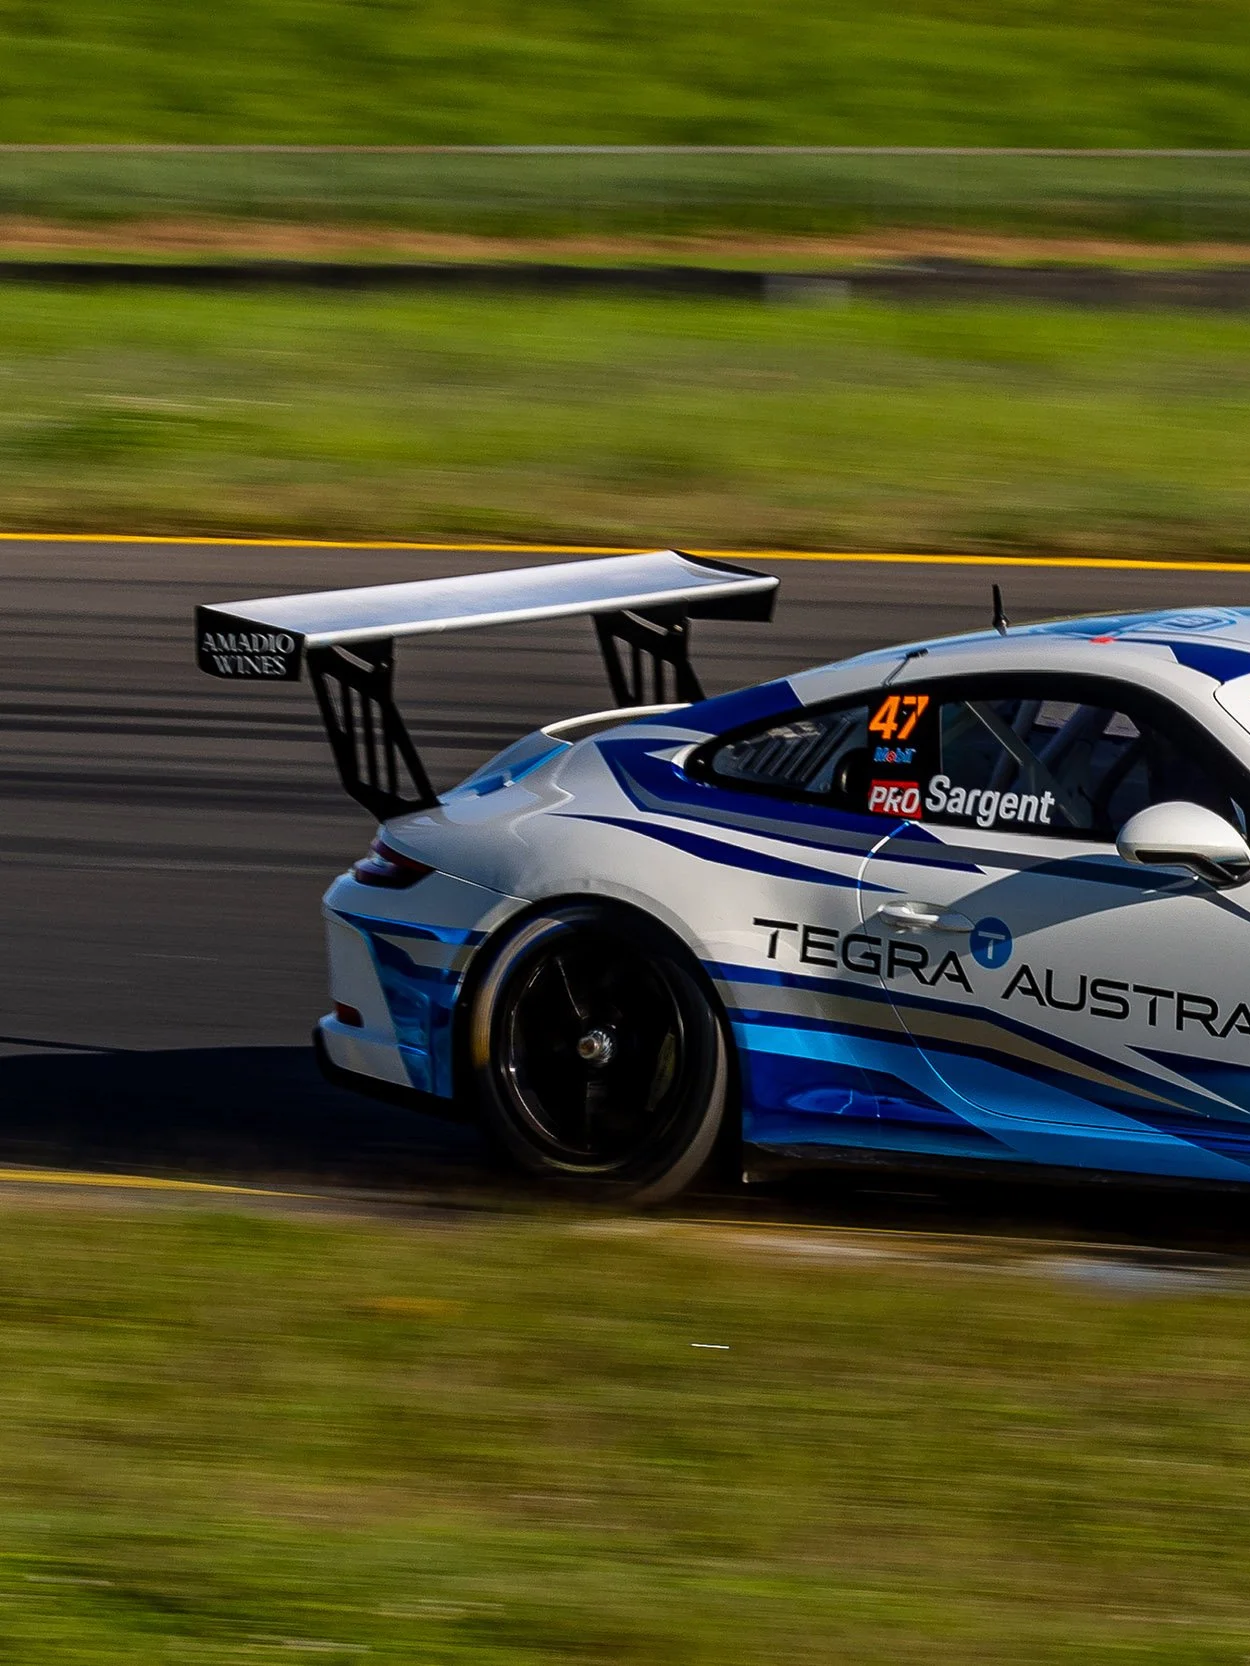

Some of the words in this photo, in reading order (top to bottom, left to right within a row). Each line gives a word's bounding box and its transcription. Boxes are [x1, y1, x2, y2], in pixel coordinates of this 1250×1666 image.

[202, 632, 296, 654] AMADIO
[212, 655, 287, 675] WINES
[869, 695, 929, 740] 47
[874, 746, 917, 763] Mobil
[869, 786, 920, 814] PRO
[925, 774, 1055, 828] Sargent
[753, 917, 974, 994] TEGRA
